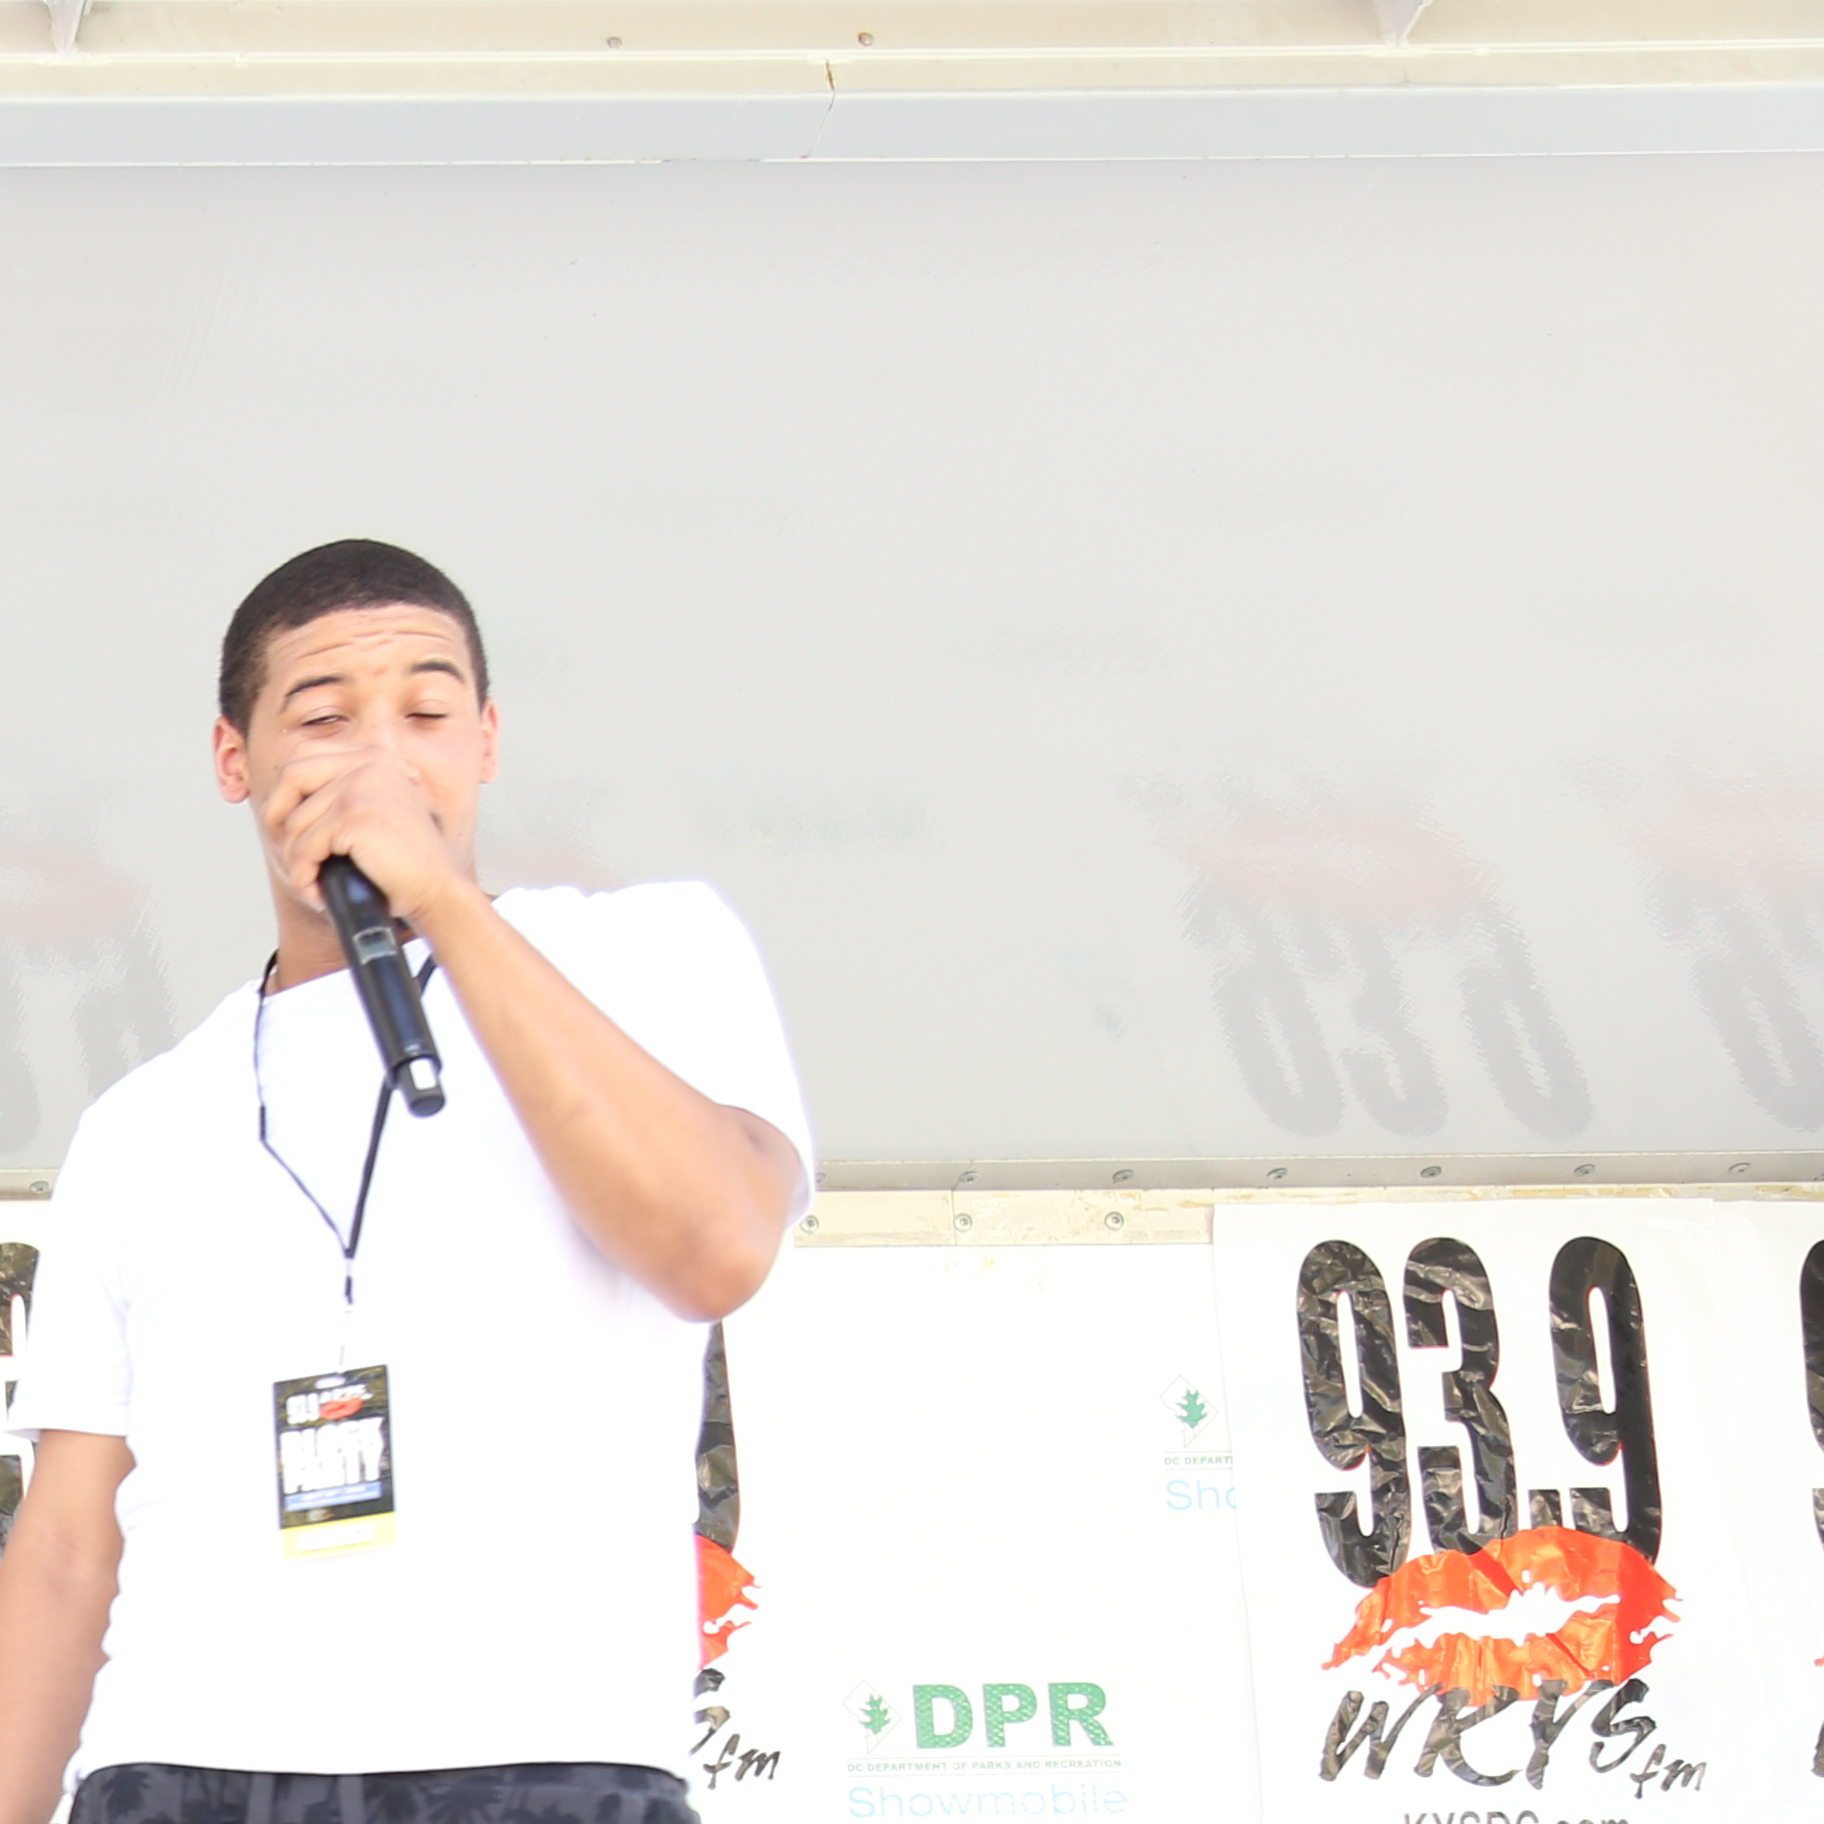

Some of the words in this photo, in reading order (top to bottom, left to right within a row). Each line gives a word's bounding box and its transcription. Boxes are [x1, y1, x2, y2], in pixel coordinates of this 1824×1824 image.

[1297, 1236, 1660, 1590] 93.9
[1164, 1457, 1180, 1466] DC
[1184, 1456, 1232, 1465] DEPART
[912, 1681, 1115, 1749] DPR
[1319, 1677, 1662, 1790] WKYS
[1635, 1744, 1706, 1799] fm
[847, 1763, 863, 1772] DC
[867, 1762, 947, 1772] DEPARTMENT
[952, 1762, 968, 1771] OF
[972, 1761, 1011, 1770] PARKS
[1016, 1760, 1040, 1769] AND
[1045, 1760, 1122, 1769] RECREATION
[848, 1783, 1128, 1818] Showmobile
